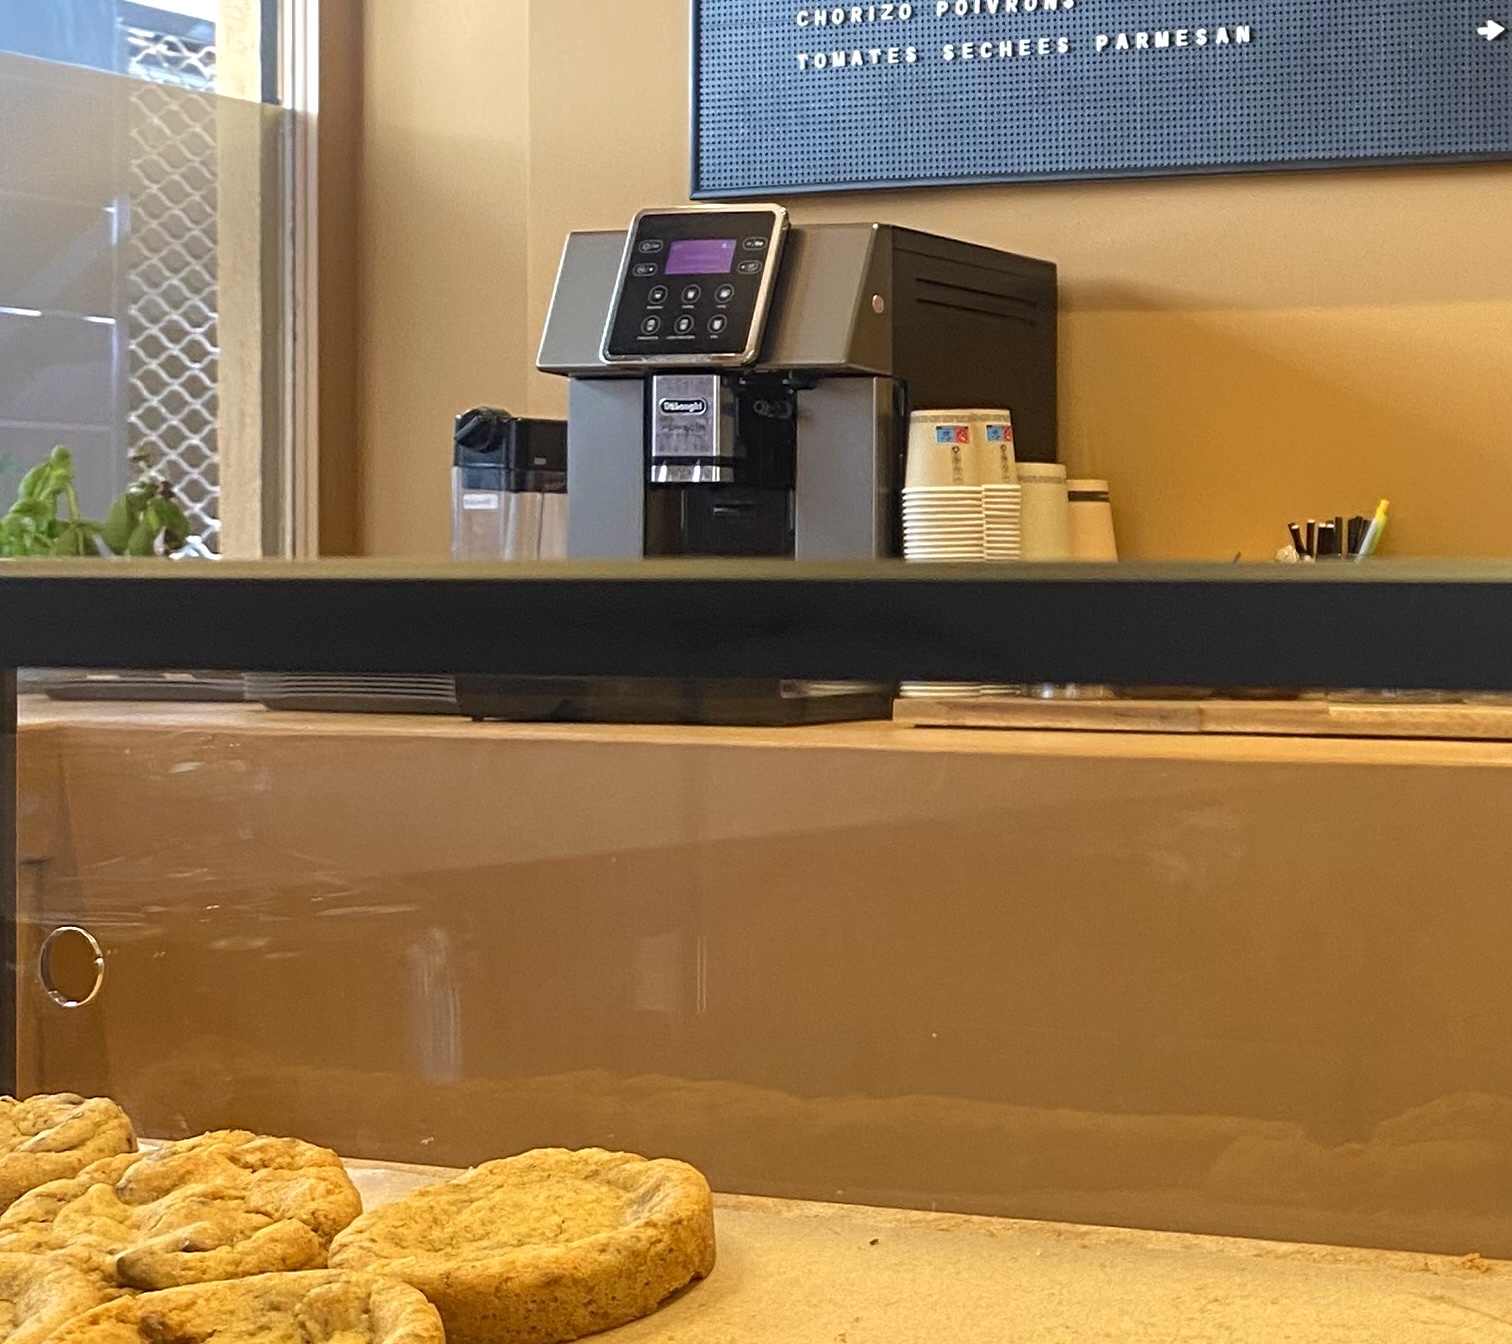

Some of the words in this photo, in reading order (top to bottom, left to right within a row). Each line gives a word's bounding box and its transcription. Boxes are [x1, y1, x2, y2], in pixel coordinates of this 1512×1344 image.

[796, 3, 912, 27] CHORIZO
[796, 46, 917, 70] TOMATES
[942, 36, 1069, 61] SECHEES
[1095, 25, 1250, 52] PARMESAN
